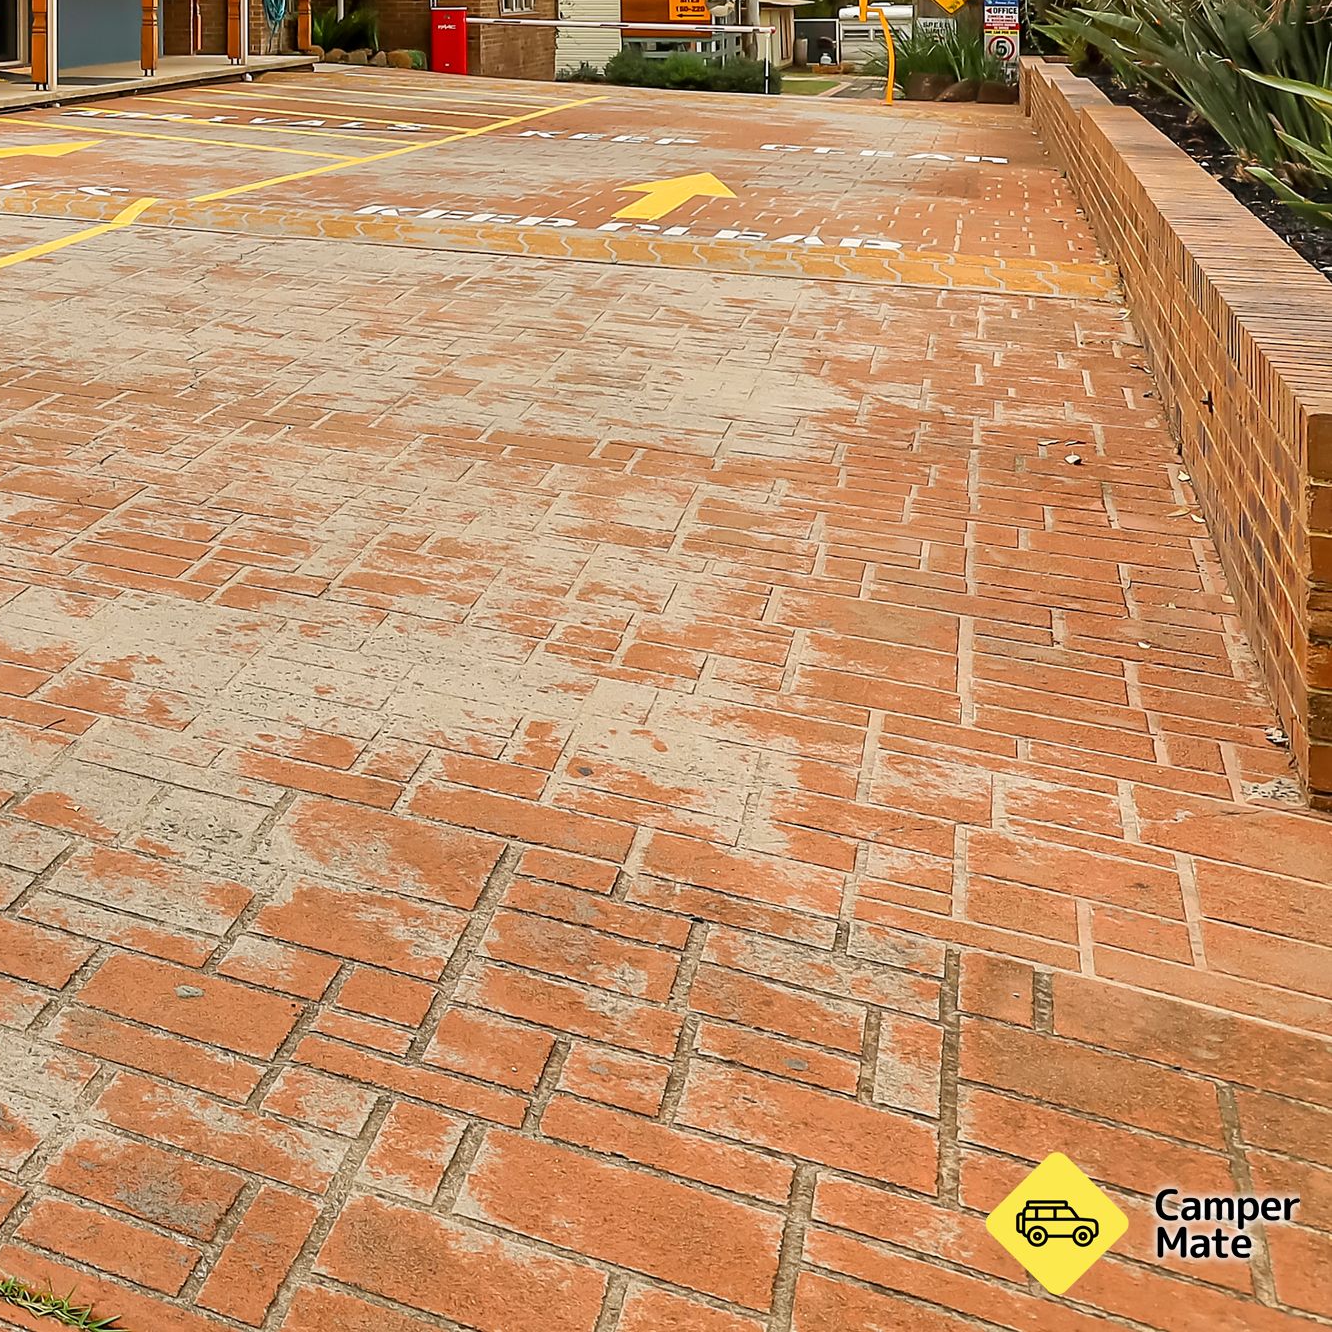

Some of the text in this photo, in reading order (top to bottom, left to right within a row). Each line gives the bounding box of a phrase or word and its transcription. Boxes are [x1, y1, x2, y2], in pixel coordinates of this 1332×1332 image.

[992, 7, 1018, 15] OFFICE
[996, 39, 1008, 57] 5
[517, 130, 1011, 164] KEEP CLEAR
[353, 204, 906, 250] KEEP CLEAR
